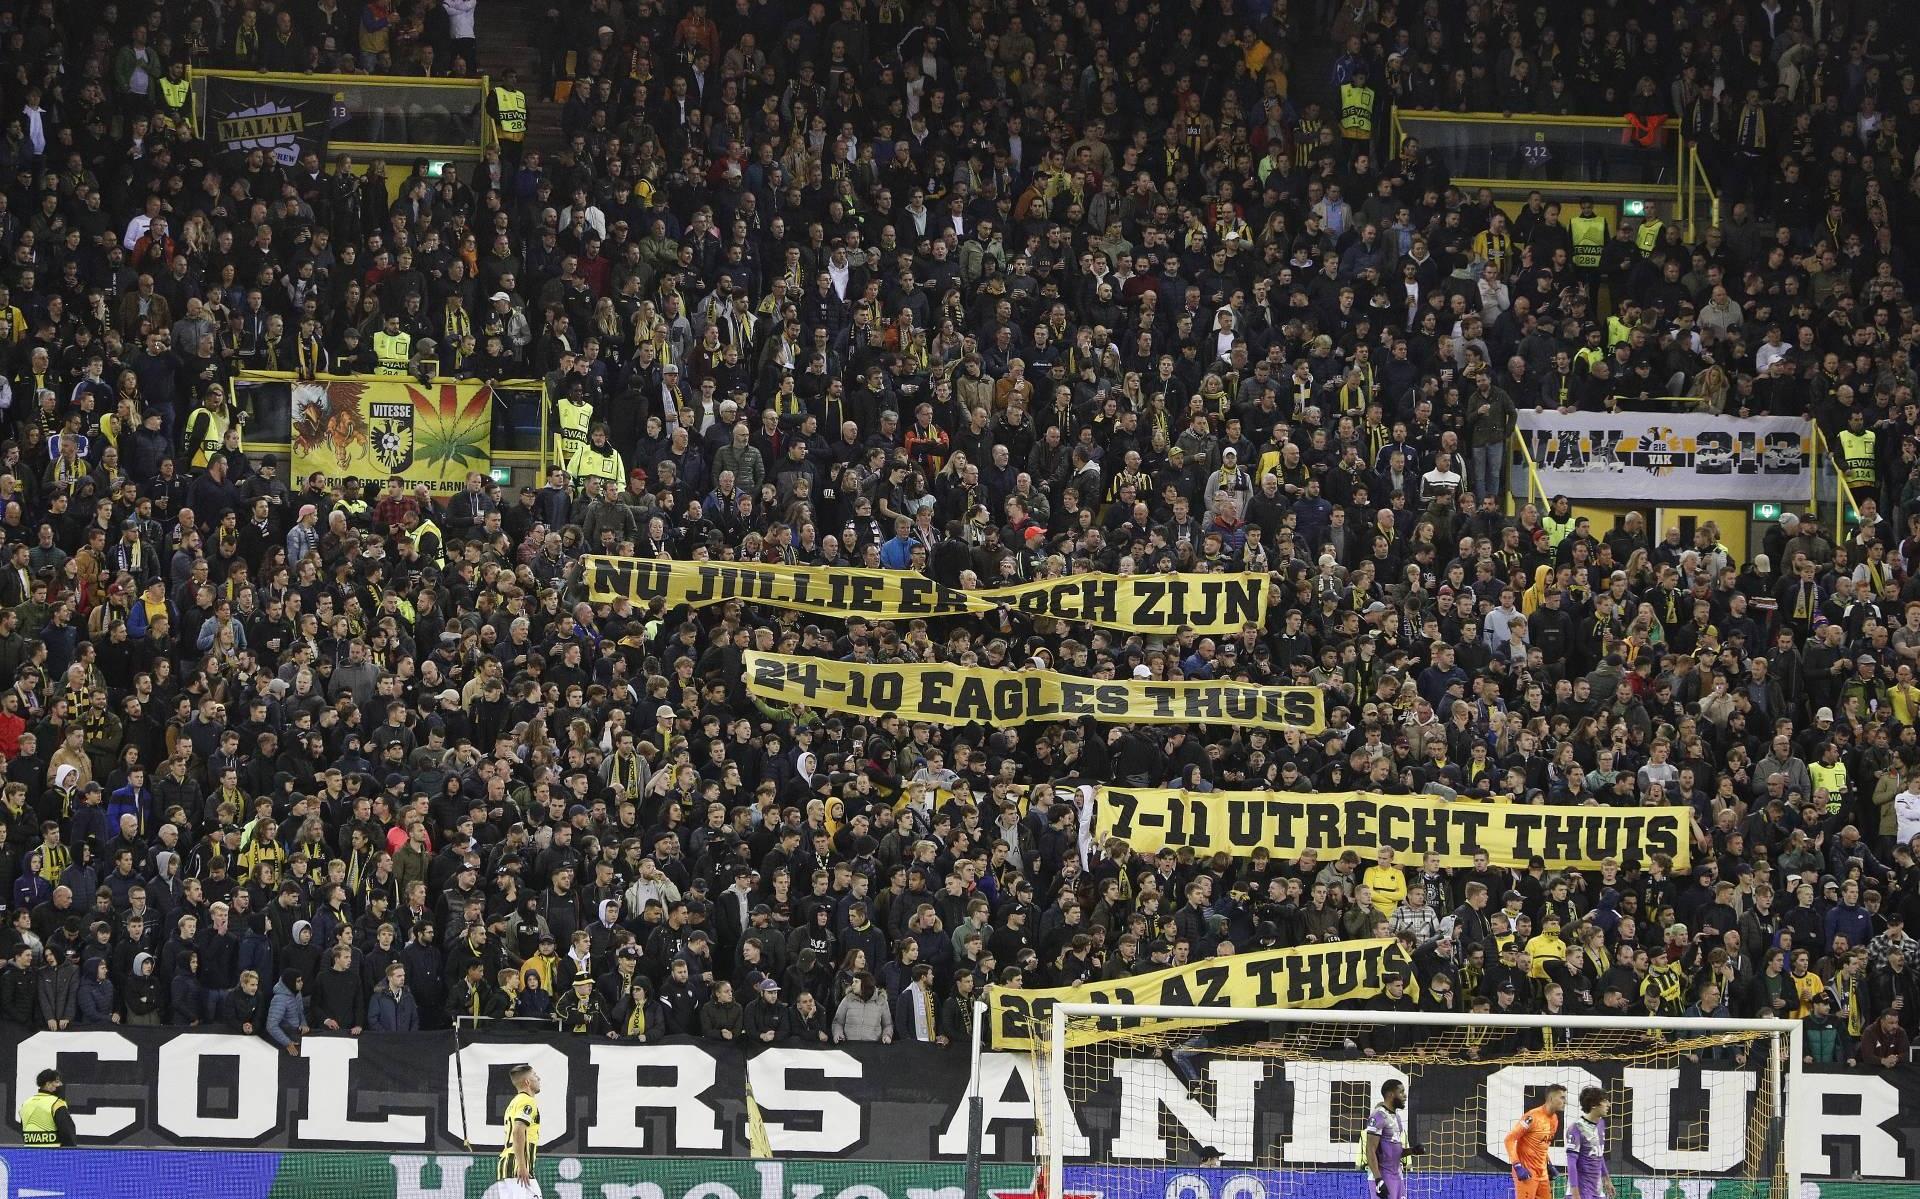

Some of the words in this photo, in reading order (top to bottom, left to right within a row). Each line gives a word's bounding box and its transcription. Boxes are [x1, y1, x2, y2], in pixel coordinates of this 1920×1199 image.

[222, 115, 299, 140] MALTA
[273, 152, 297, 164] REW
[1525, 146, 1548, 157] 212
[1580, 257, 1596, 265] 289
[373, 404, 411, 418] VITESSE
[1652, 443, 1667, 452] 212
[1696, 431, 1801, 474] 212
[1648, 454, 1672, 465] VAK
[1856, 470, 1871, 478] 124
[594, 558, 673, 601] NU
[898, 577, 969, 613] ER
[1132, 579, 1262, 626] ZIJN
[754, 658, 903, 715] 24-10
[917, 671, 1129, 721] EAGLES
[1145, 687, 1317, 728] THUIS
[1107, 791, 1211, 848] 7-11
[1226, 800, 1489, 857] UTRECHT
[1505, 813, 1680, 861] THUIS
[1158, 966, 1230, 1020] AZ
[15, 1031, 863, 1154] COLORS
[938, 1052, 1408, 1166] AND
[1486, 1066, 1906, 1178] OUR
